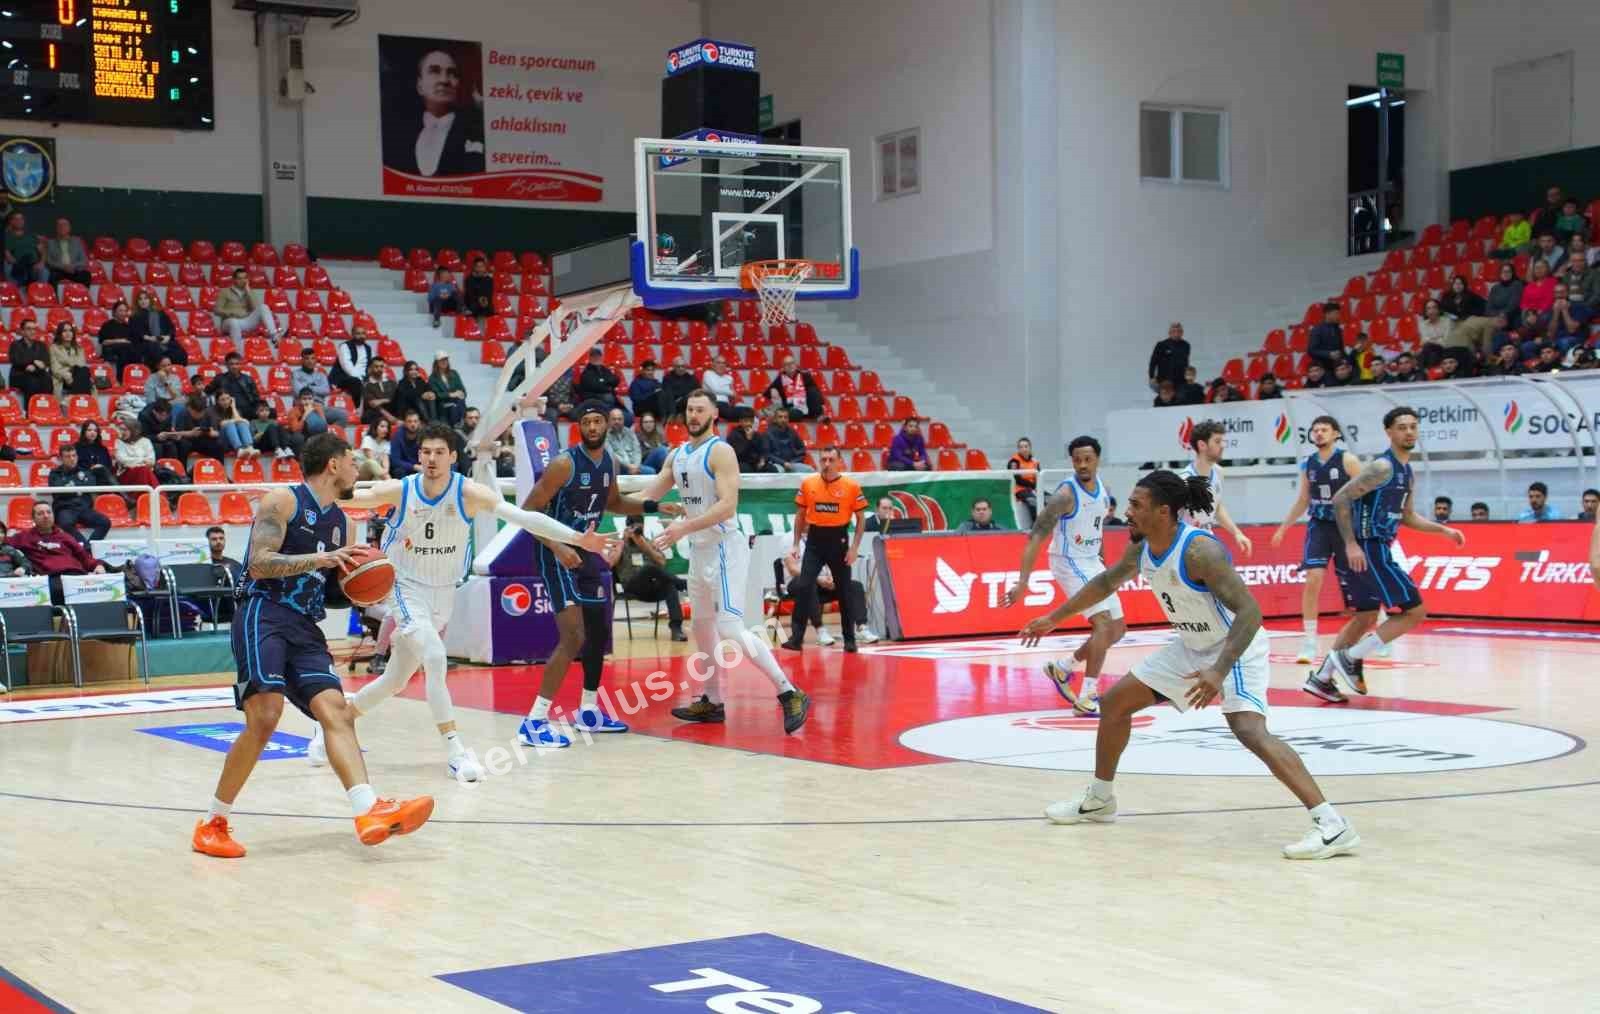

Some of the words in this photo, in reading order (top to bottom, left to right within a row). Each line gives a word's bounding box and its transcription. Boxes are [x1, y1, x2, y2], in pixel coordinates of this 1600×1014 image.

[49, 44, 55, 69] 1
[488, 50, 516, 65] Ben
[519, 55, 597, 70] sporcunun
[489, 82, 524, 101] zeki,
[526, 86, 563, 103] çevik
[567, 90, 584, 103] ve
[490, 115, 567, 134] ahlaklısını
[1417, 405, 1479, 425] Petkim
[425, 522, 434, 540] 6
[1419, 556, 1498, 591] TFS
[980, 570, 1056, 608] TFS
[1161, 592, 1176, 614] 3
[1168, 726, 1476, 761] Ptkim
[649, 966, 826, 1014] Te
